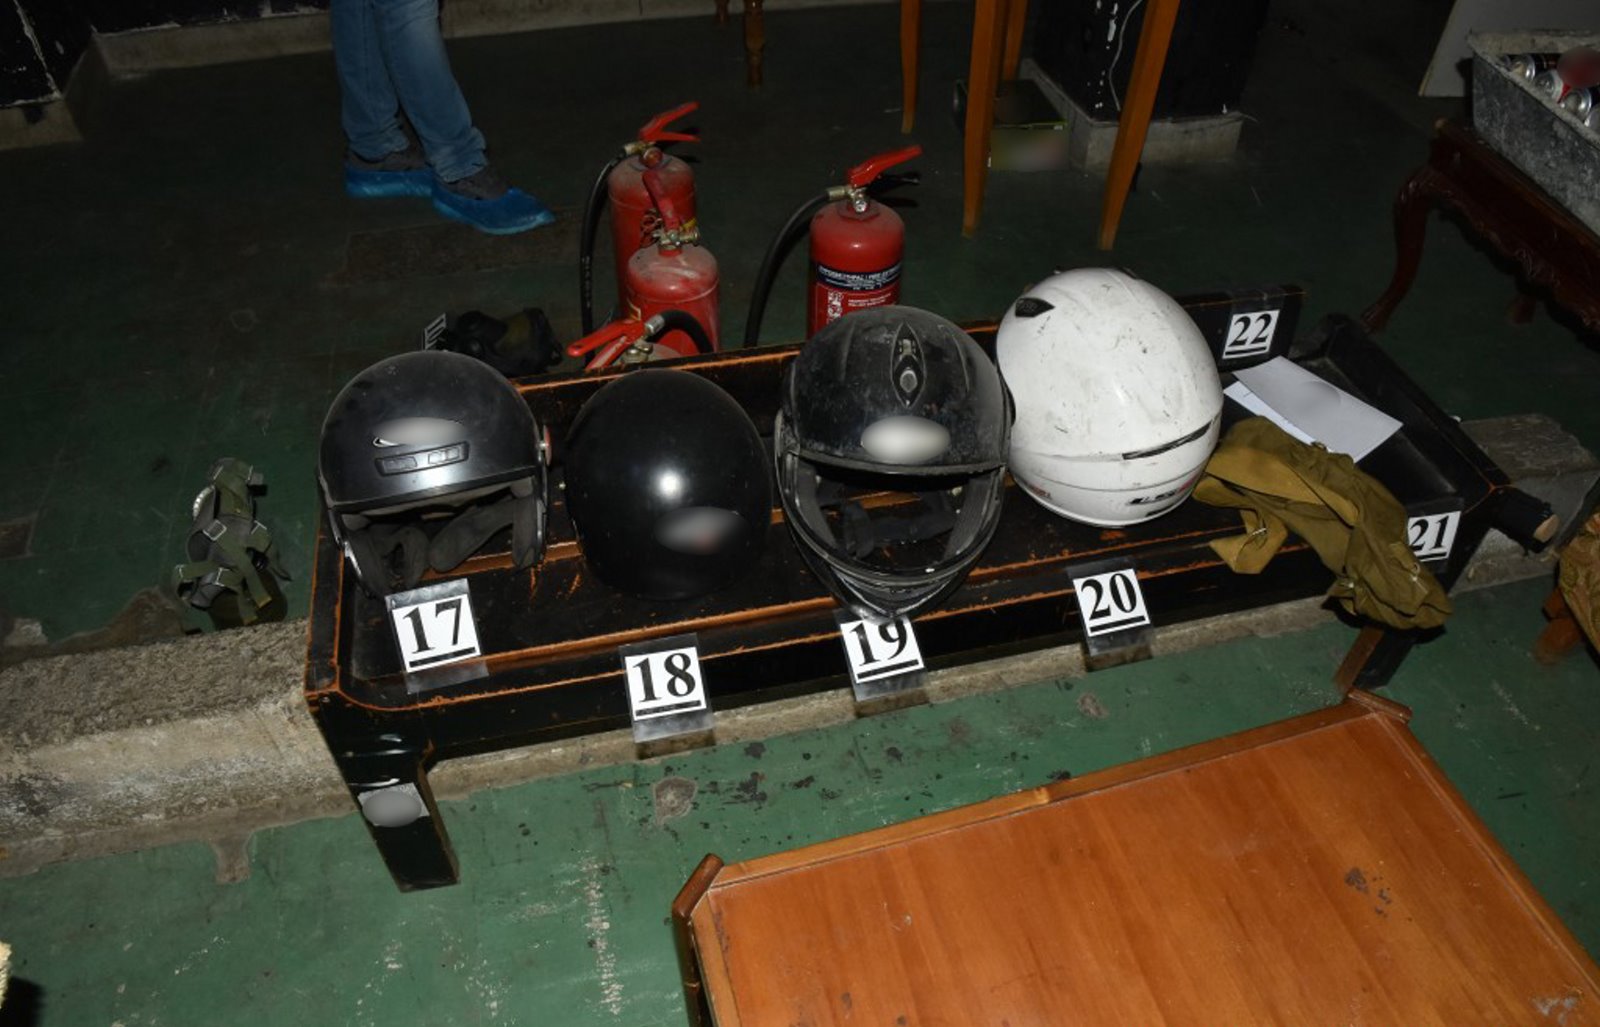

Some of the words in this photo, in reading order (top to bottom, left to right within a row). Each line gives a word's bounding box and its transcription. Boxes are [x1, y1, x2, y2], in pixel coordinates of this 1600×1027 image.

[1228, 313, 1272, 347] 22
[1409, 515, 1449, 551] 21
[1081, 573, 1137, 620] 20
[404, 598, 463, 653] 17
[850, 620, 907, 666] 19
[633, 652, 696, 702] 18
